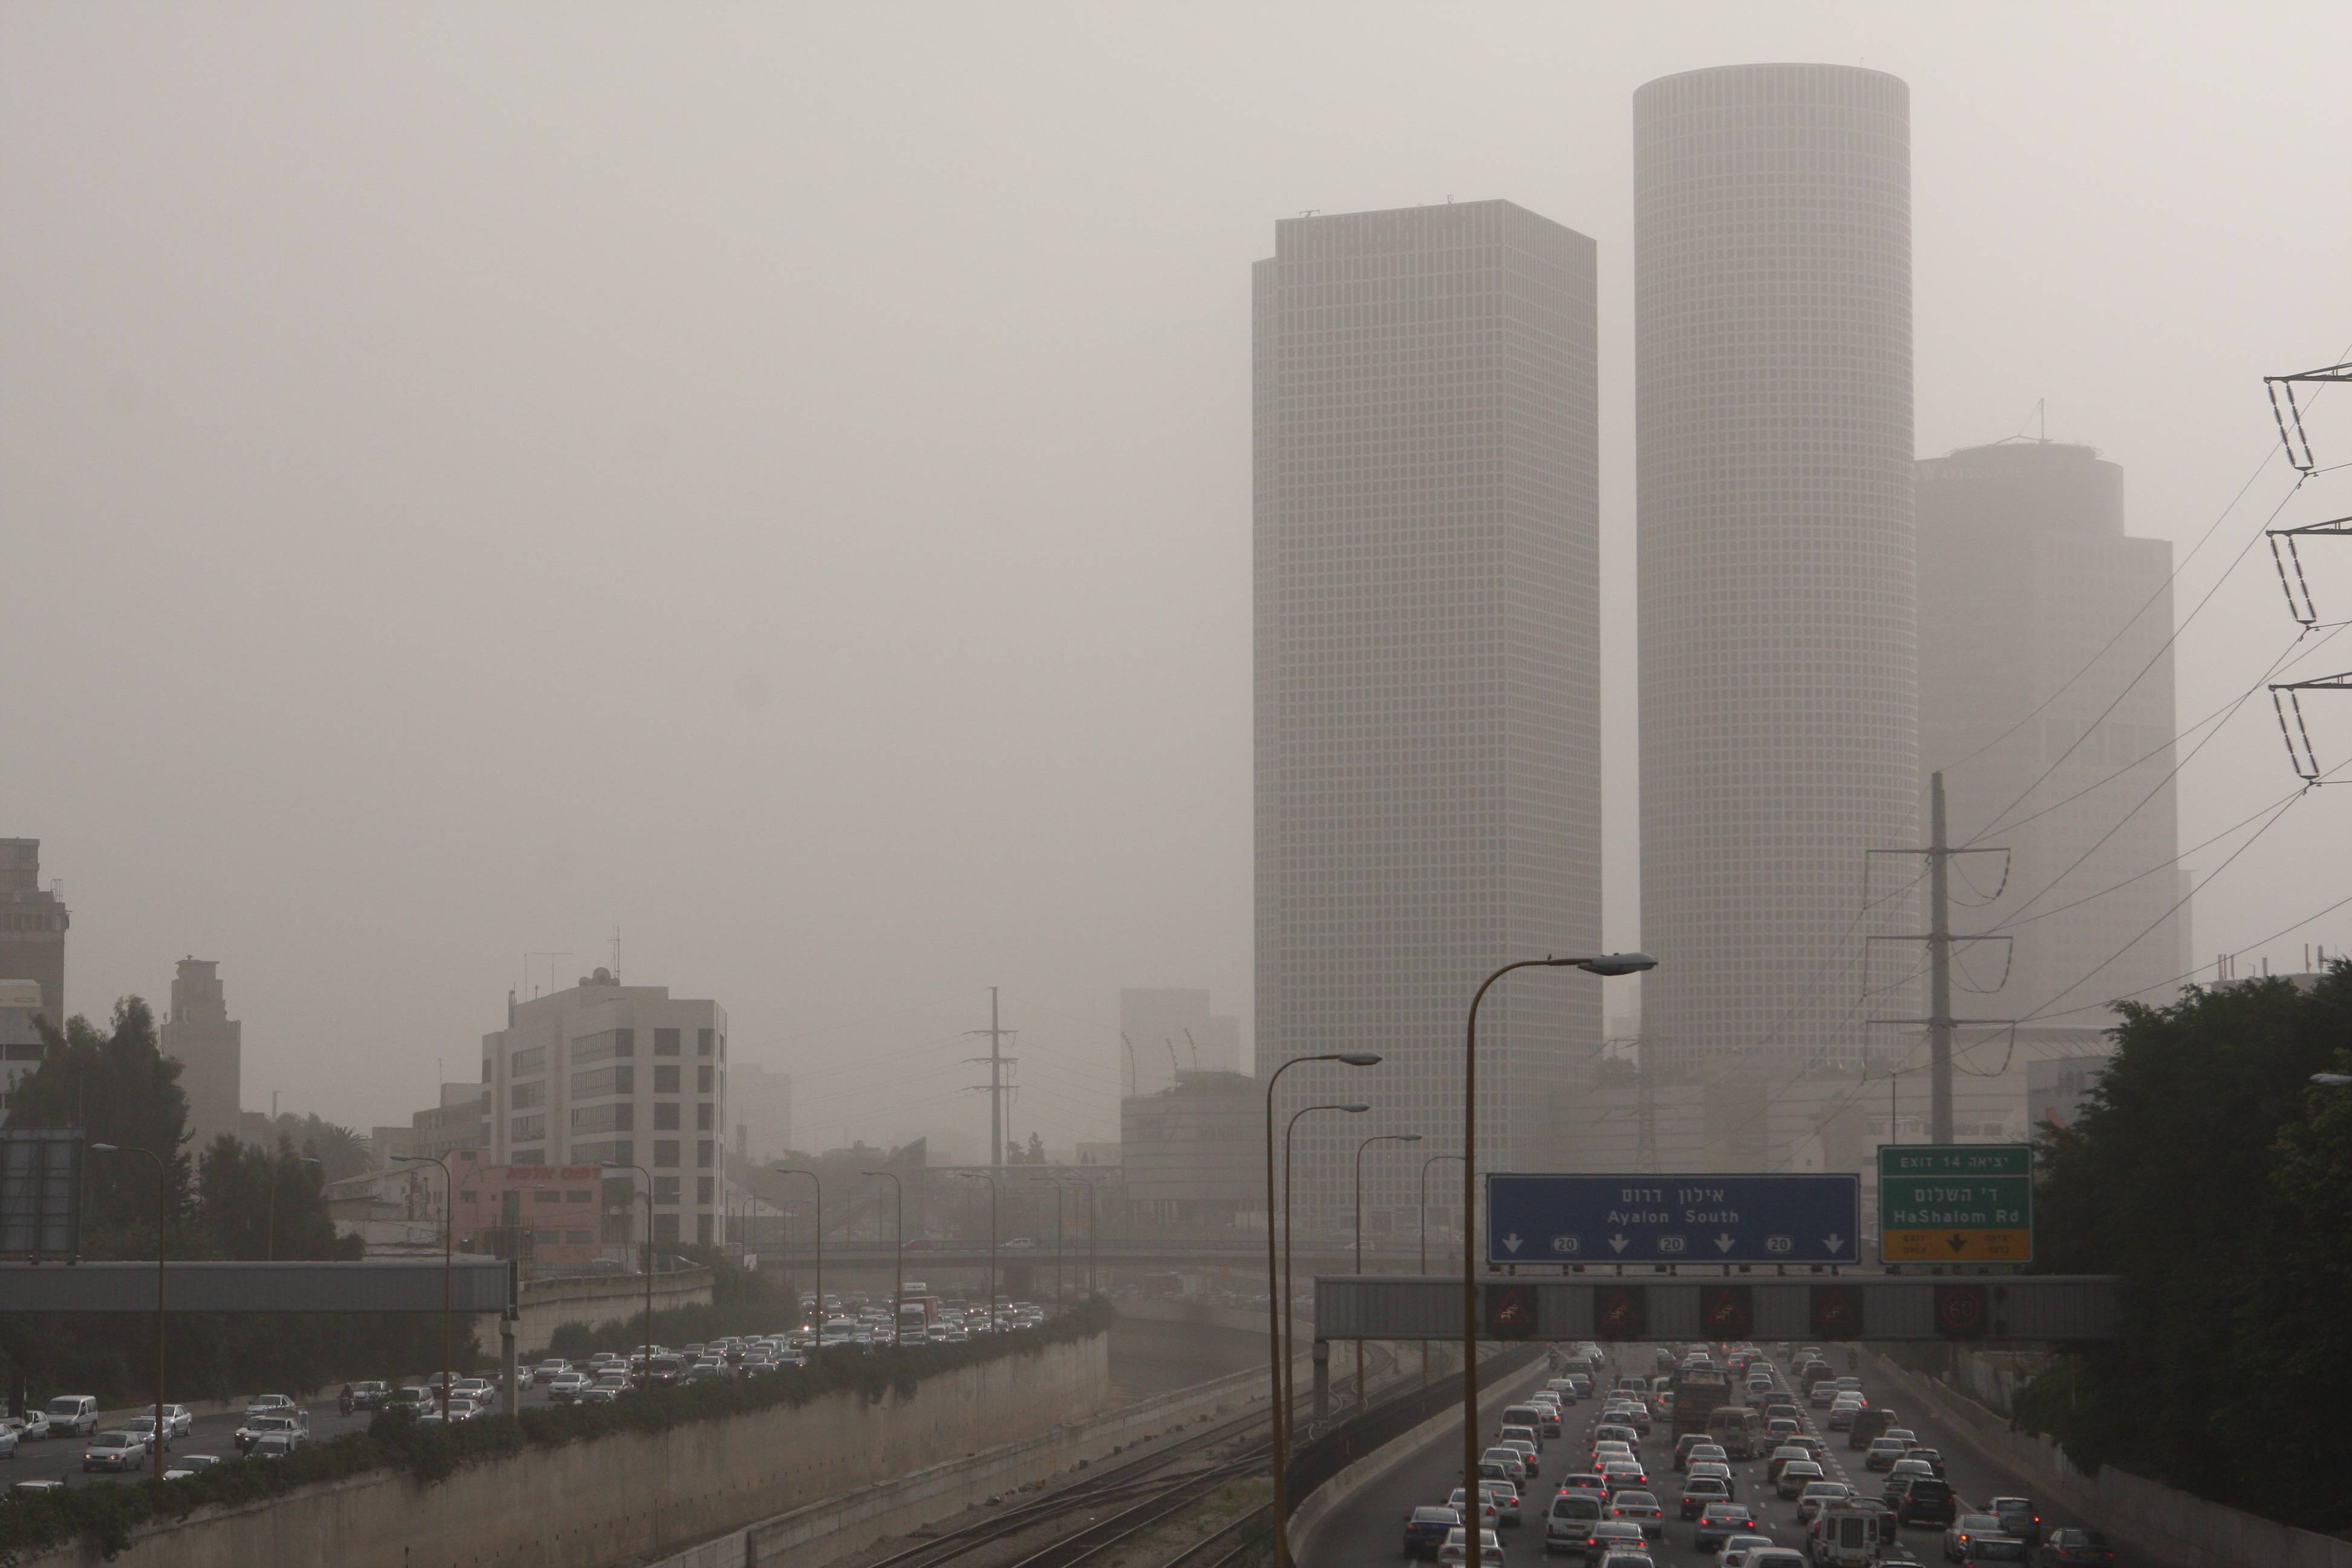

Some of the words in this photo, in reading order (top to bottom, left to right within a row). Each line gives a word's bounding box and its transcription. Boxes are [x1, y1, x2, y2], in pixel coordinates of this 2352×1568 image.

[1900, 1157, 1933, 1168] EXIT
[1943, 1156, 1960, 1167] 14
[1968, 1156, 2008, 1168] יציאה
[1622, 1189, 1662, 1202] דרום
[1678, 1187, 1723, 1204] אילון
[1914, 1186, 1971, 1202] השלום
[1607, 1209, 1669, 1226] Ayalon
[1685, 1209, 1739, 1223] South
[1893, 1209, 1986, 1223] HaShalom
[1996, 1209, 2018, 1223] Rd
[1558, 1238, 1574, 1250] 20
[1664, 1238, 1681, 1250] 20
[1771, 1238, 1788, 1250] 20
